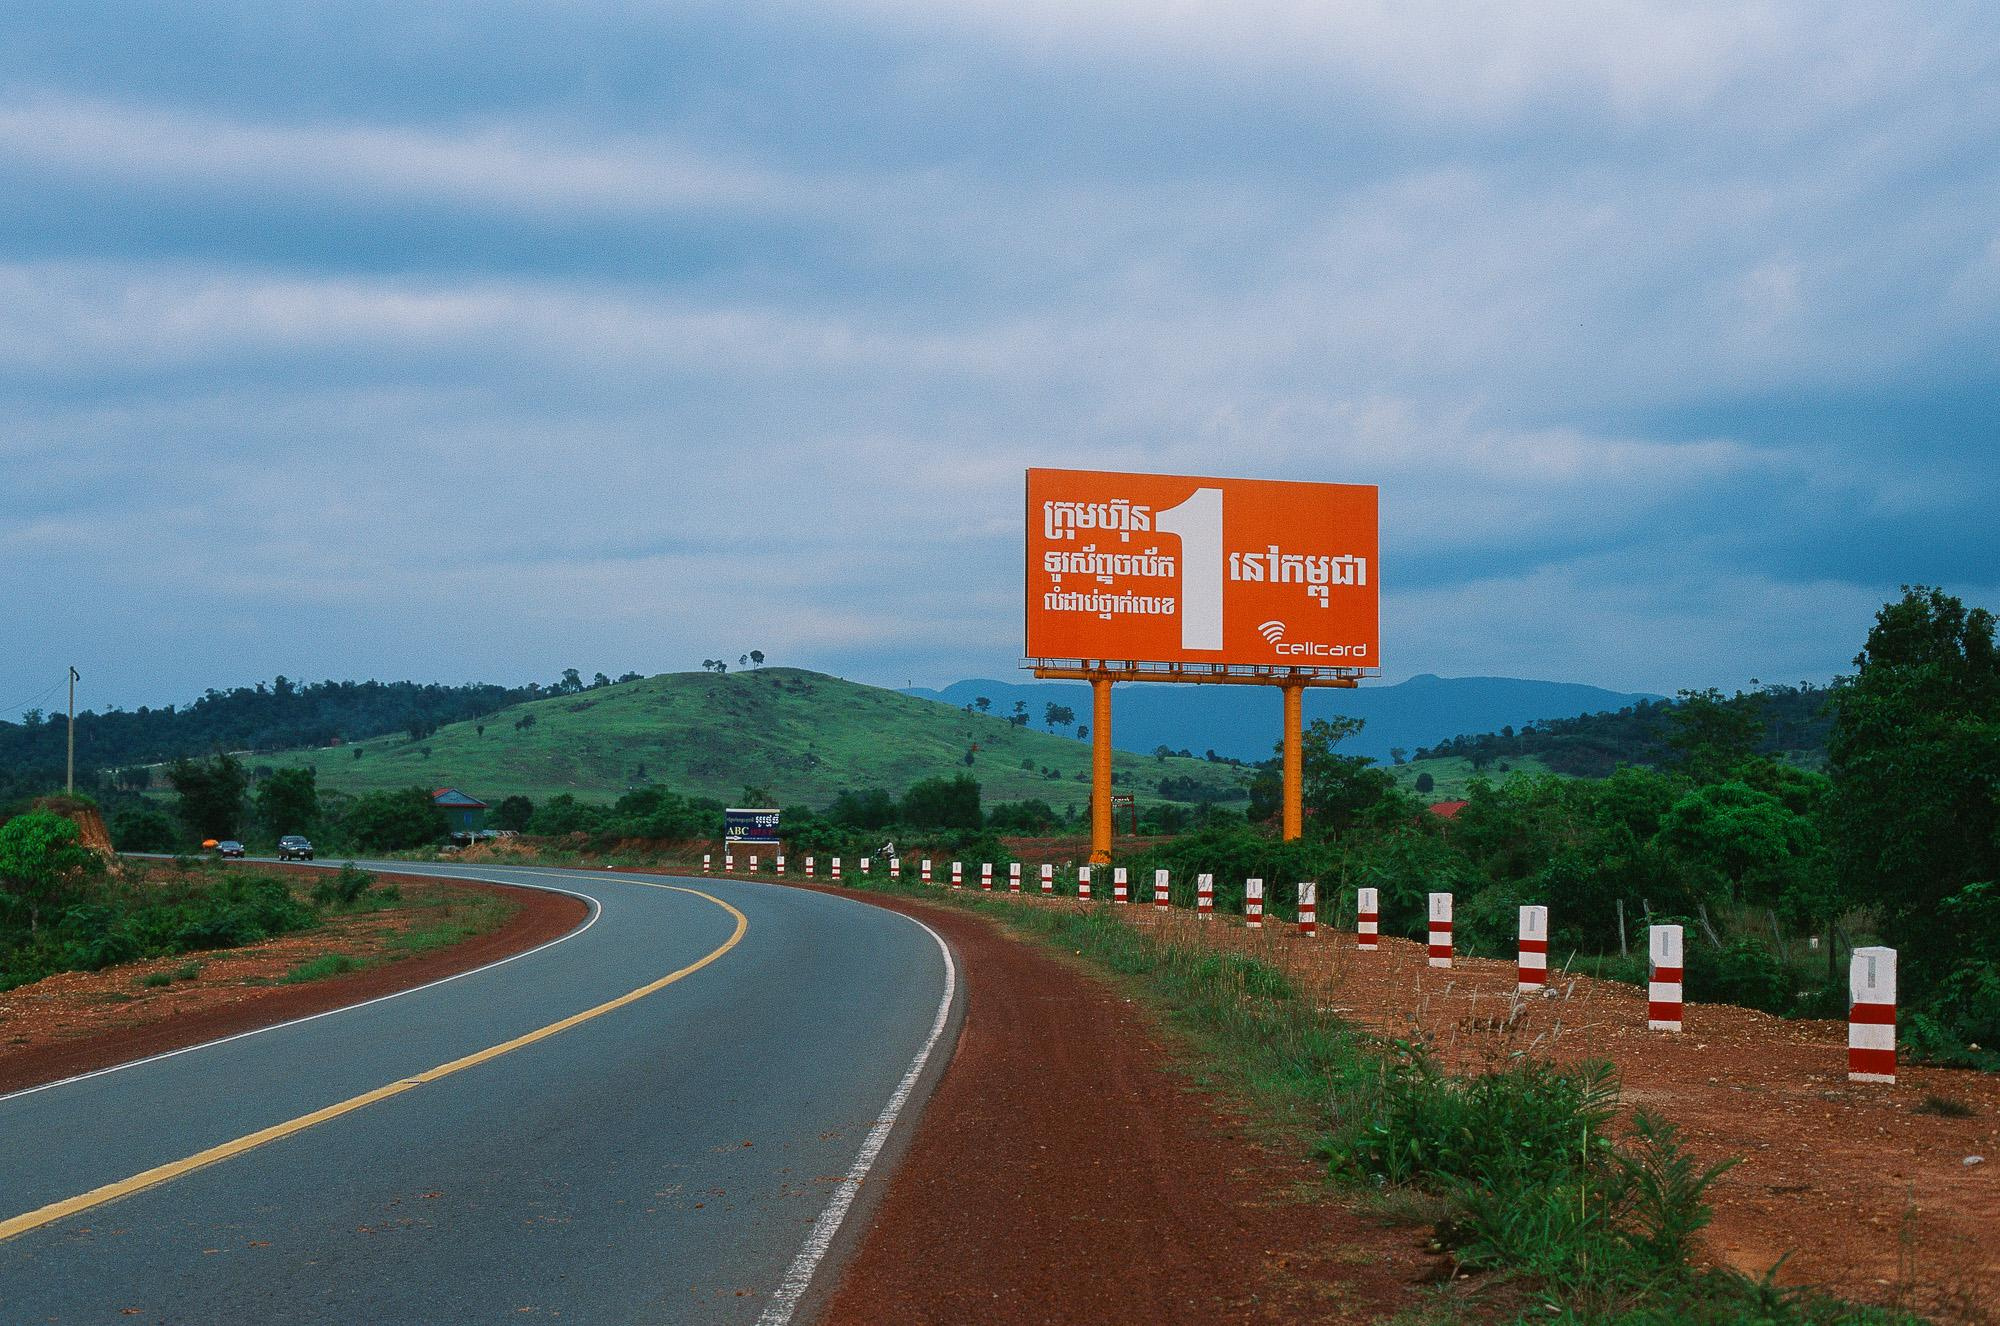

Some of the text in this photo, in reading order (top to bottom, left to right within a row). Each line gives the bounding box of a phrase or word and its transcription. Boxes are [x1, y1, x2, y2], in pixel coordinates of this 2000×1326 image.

[1043, 498, 1150, 542] ក្រុមហ៊ុន
[1156, 487, 1223, 651] 1
[1229, 545, 1366, 608] នៅកម្ពុជា
[1275, 641, 1367, 657] cellcard
[727, 826, 750, 836] ABC
